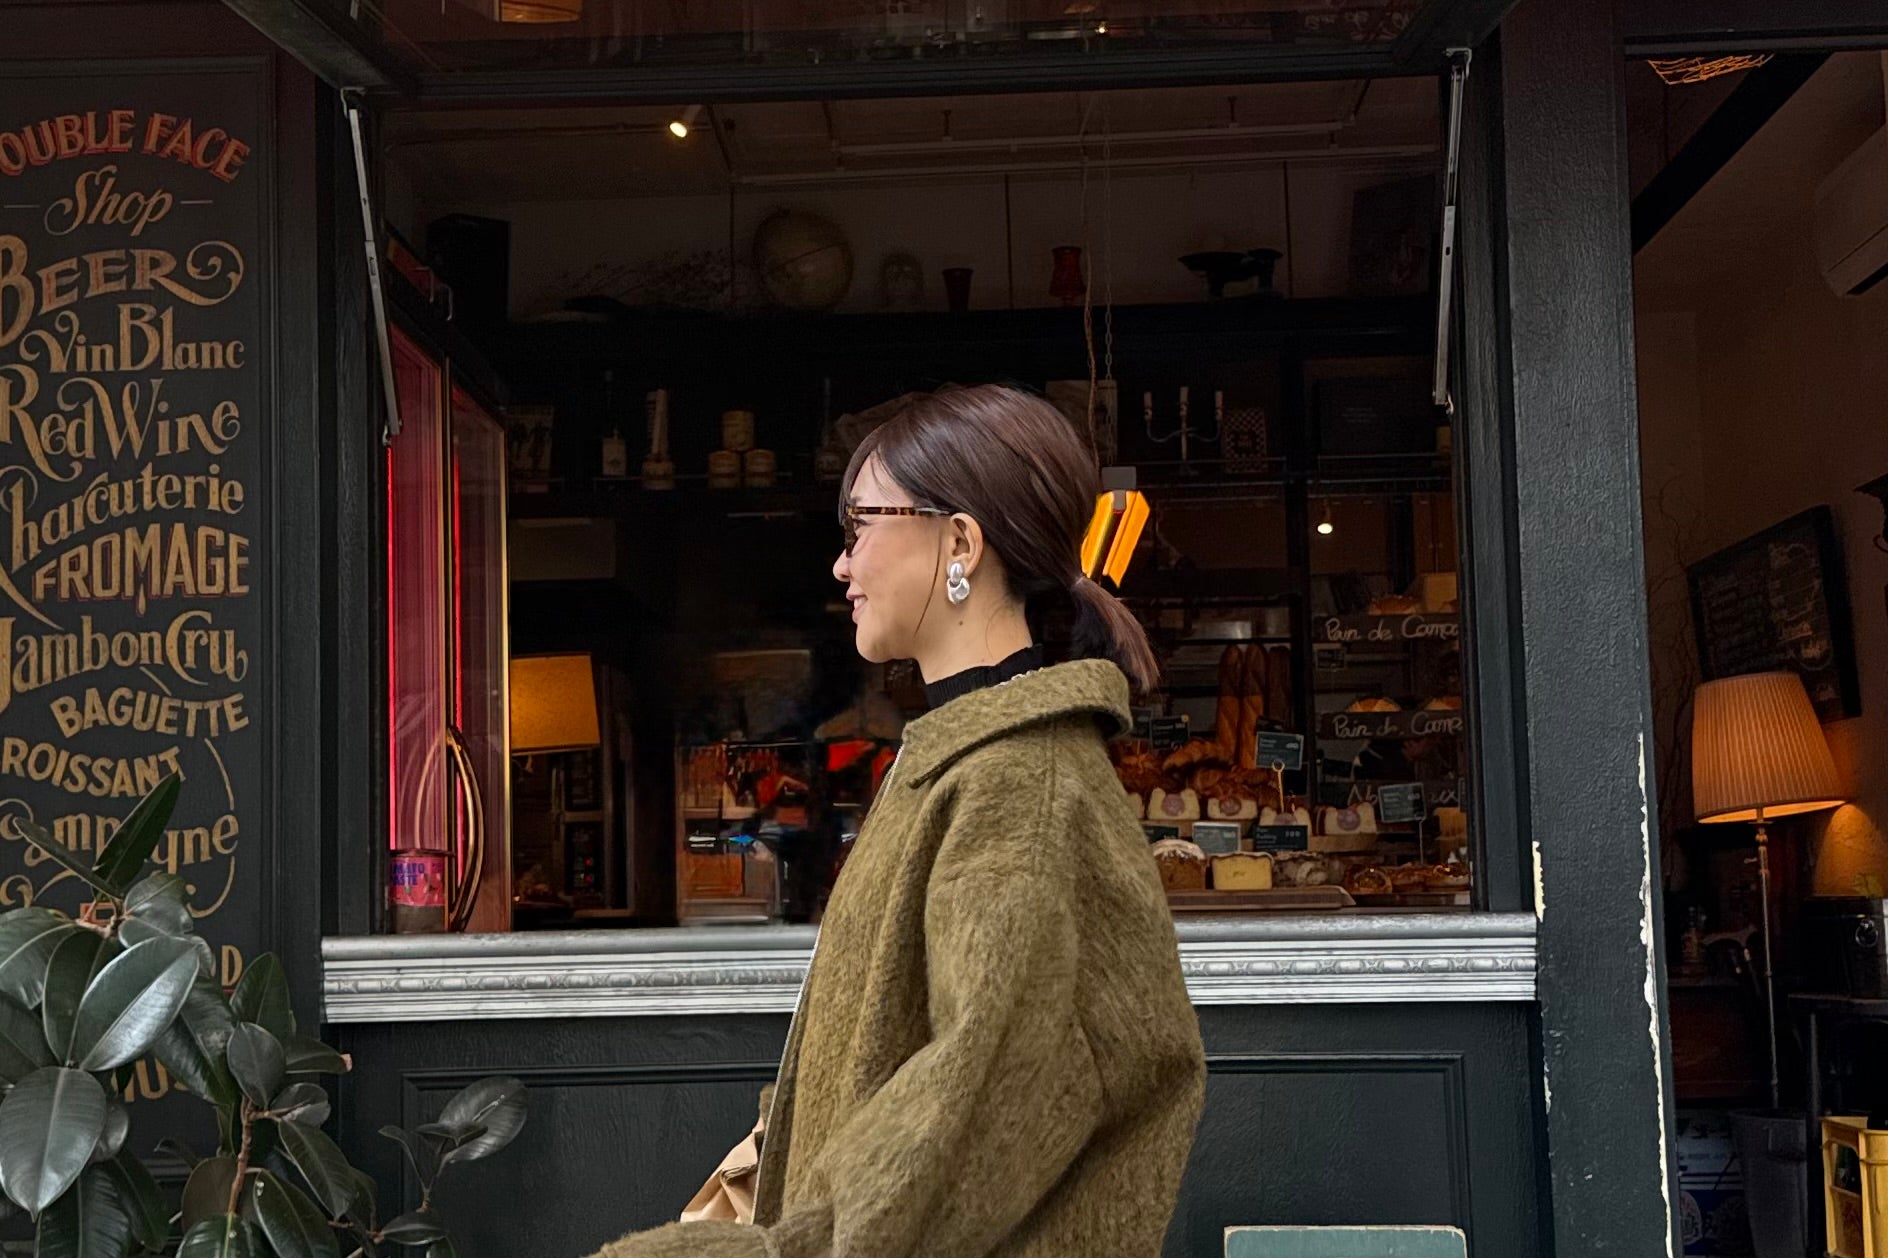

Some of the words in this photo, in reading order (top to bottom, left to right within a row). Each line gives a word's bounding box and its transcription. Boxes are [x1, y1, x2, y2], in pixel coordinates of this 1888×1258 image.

[143, 112, 251, 184] FACE
[44, 165, 173, 237] Shop
[0, 234, 245, 347] BEER
[33, 522, 250, 604] FROMAGE
[50, 687, 250, 739] BAGUETTE
